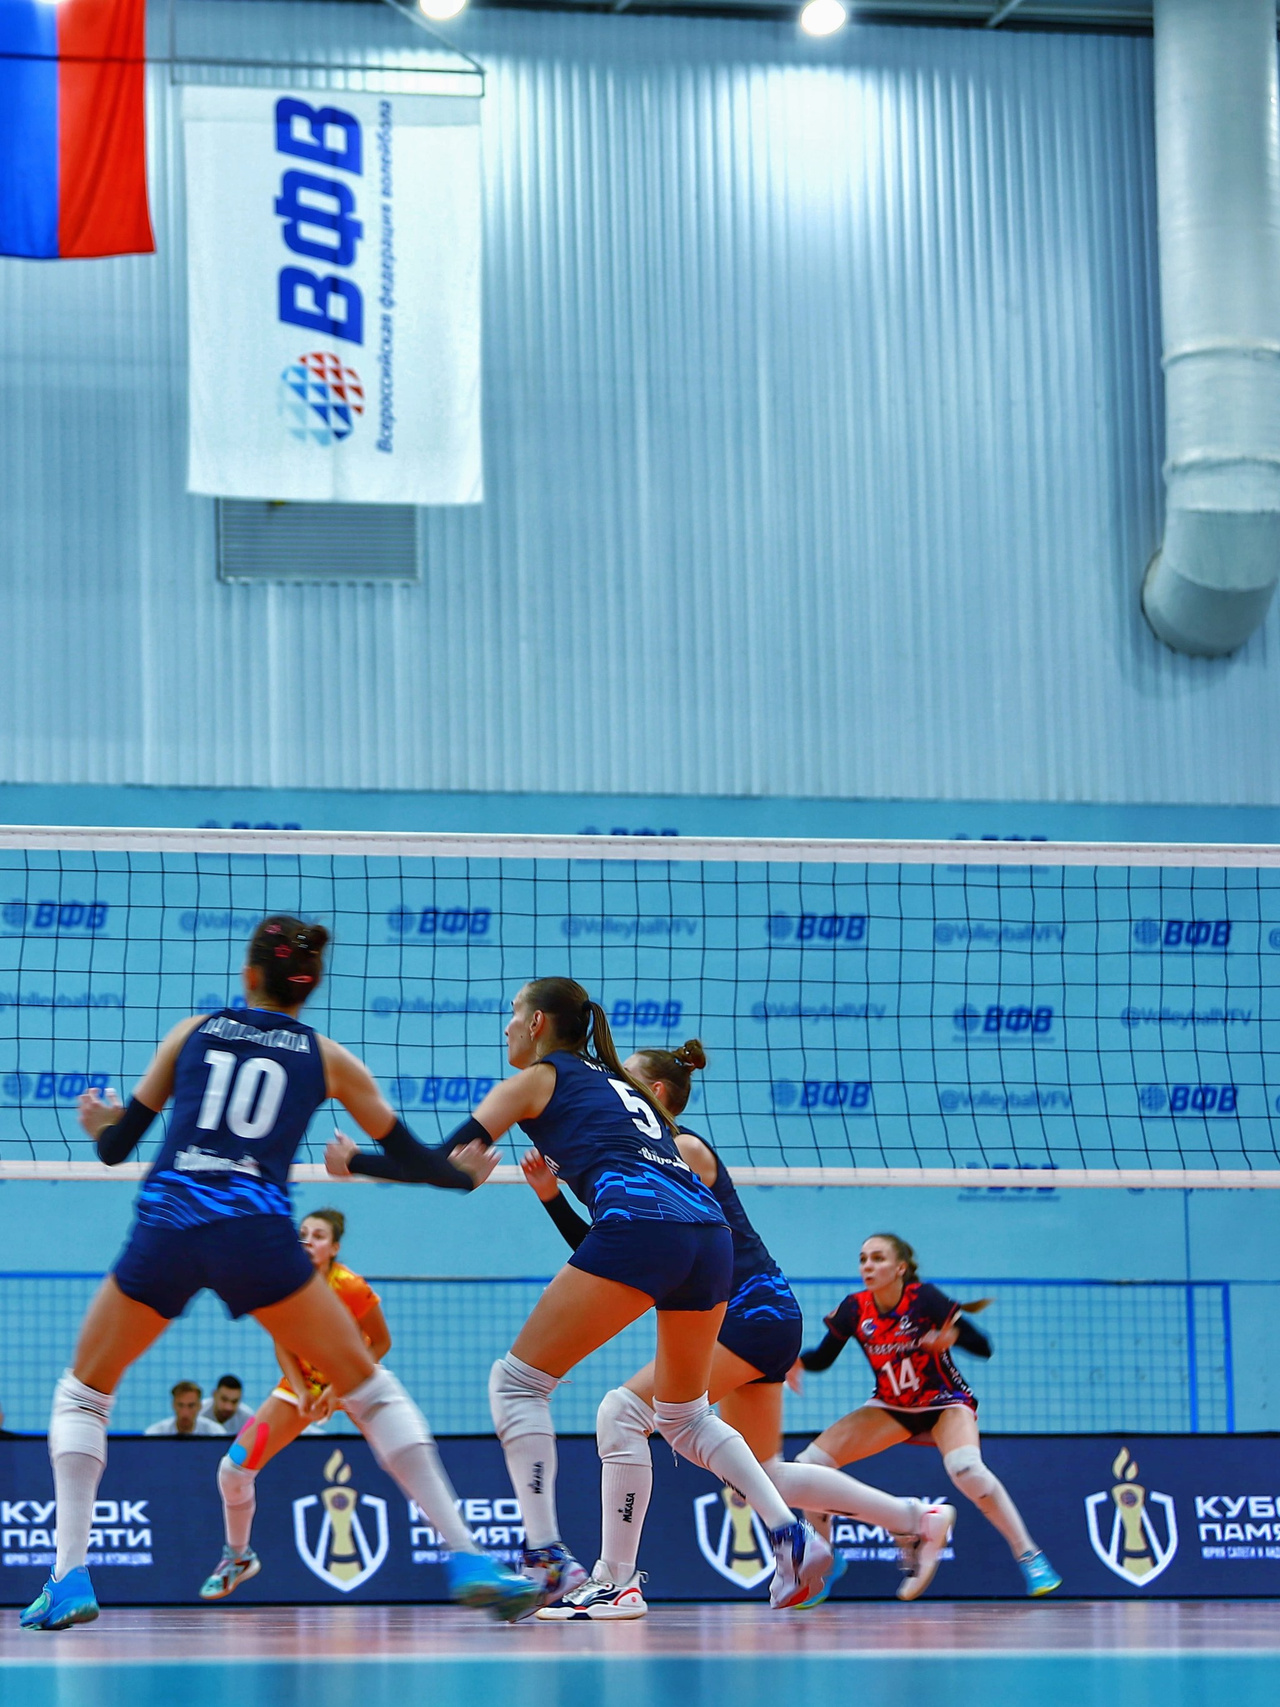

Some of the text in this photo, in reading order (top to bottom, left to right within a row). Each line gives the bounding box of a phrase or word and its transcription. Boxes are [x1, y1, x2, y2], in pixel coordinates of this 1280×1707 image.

[273, 95, 365, 347] ВФВ
[375, 100, 398, 455] Всероссийская федерация волейбола
[33, 899, 110, 930] ВФВ
[417, 906, 492, 935] ВФВ
[795, 912, 867, 941] ВФВ
[1163, 917, 1232, 947] ВФВ
[611, 998, 684, 1028] ВФВ
[982, 1004, 1054, 1034] ВФВ
[195, 1049, 289, 1139] 10
[607, 1077, 663, 1140] 5
[799, 1079, 871, 1109] ВФВ
[1169, 1085, 1239, 1114] ВФВ
[881, 1357, 920, 1397] 14
[1, 1501, 150, 1524] КУОК
[1195, 1496, 1280, 1518] КУБ
[2, 1528, 152, 1548] ПАЯТИ
